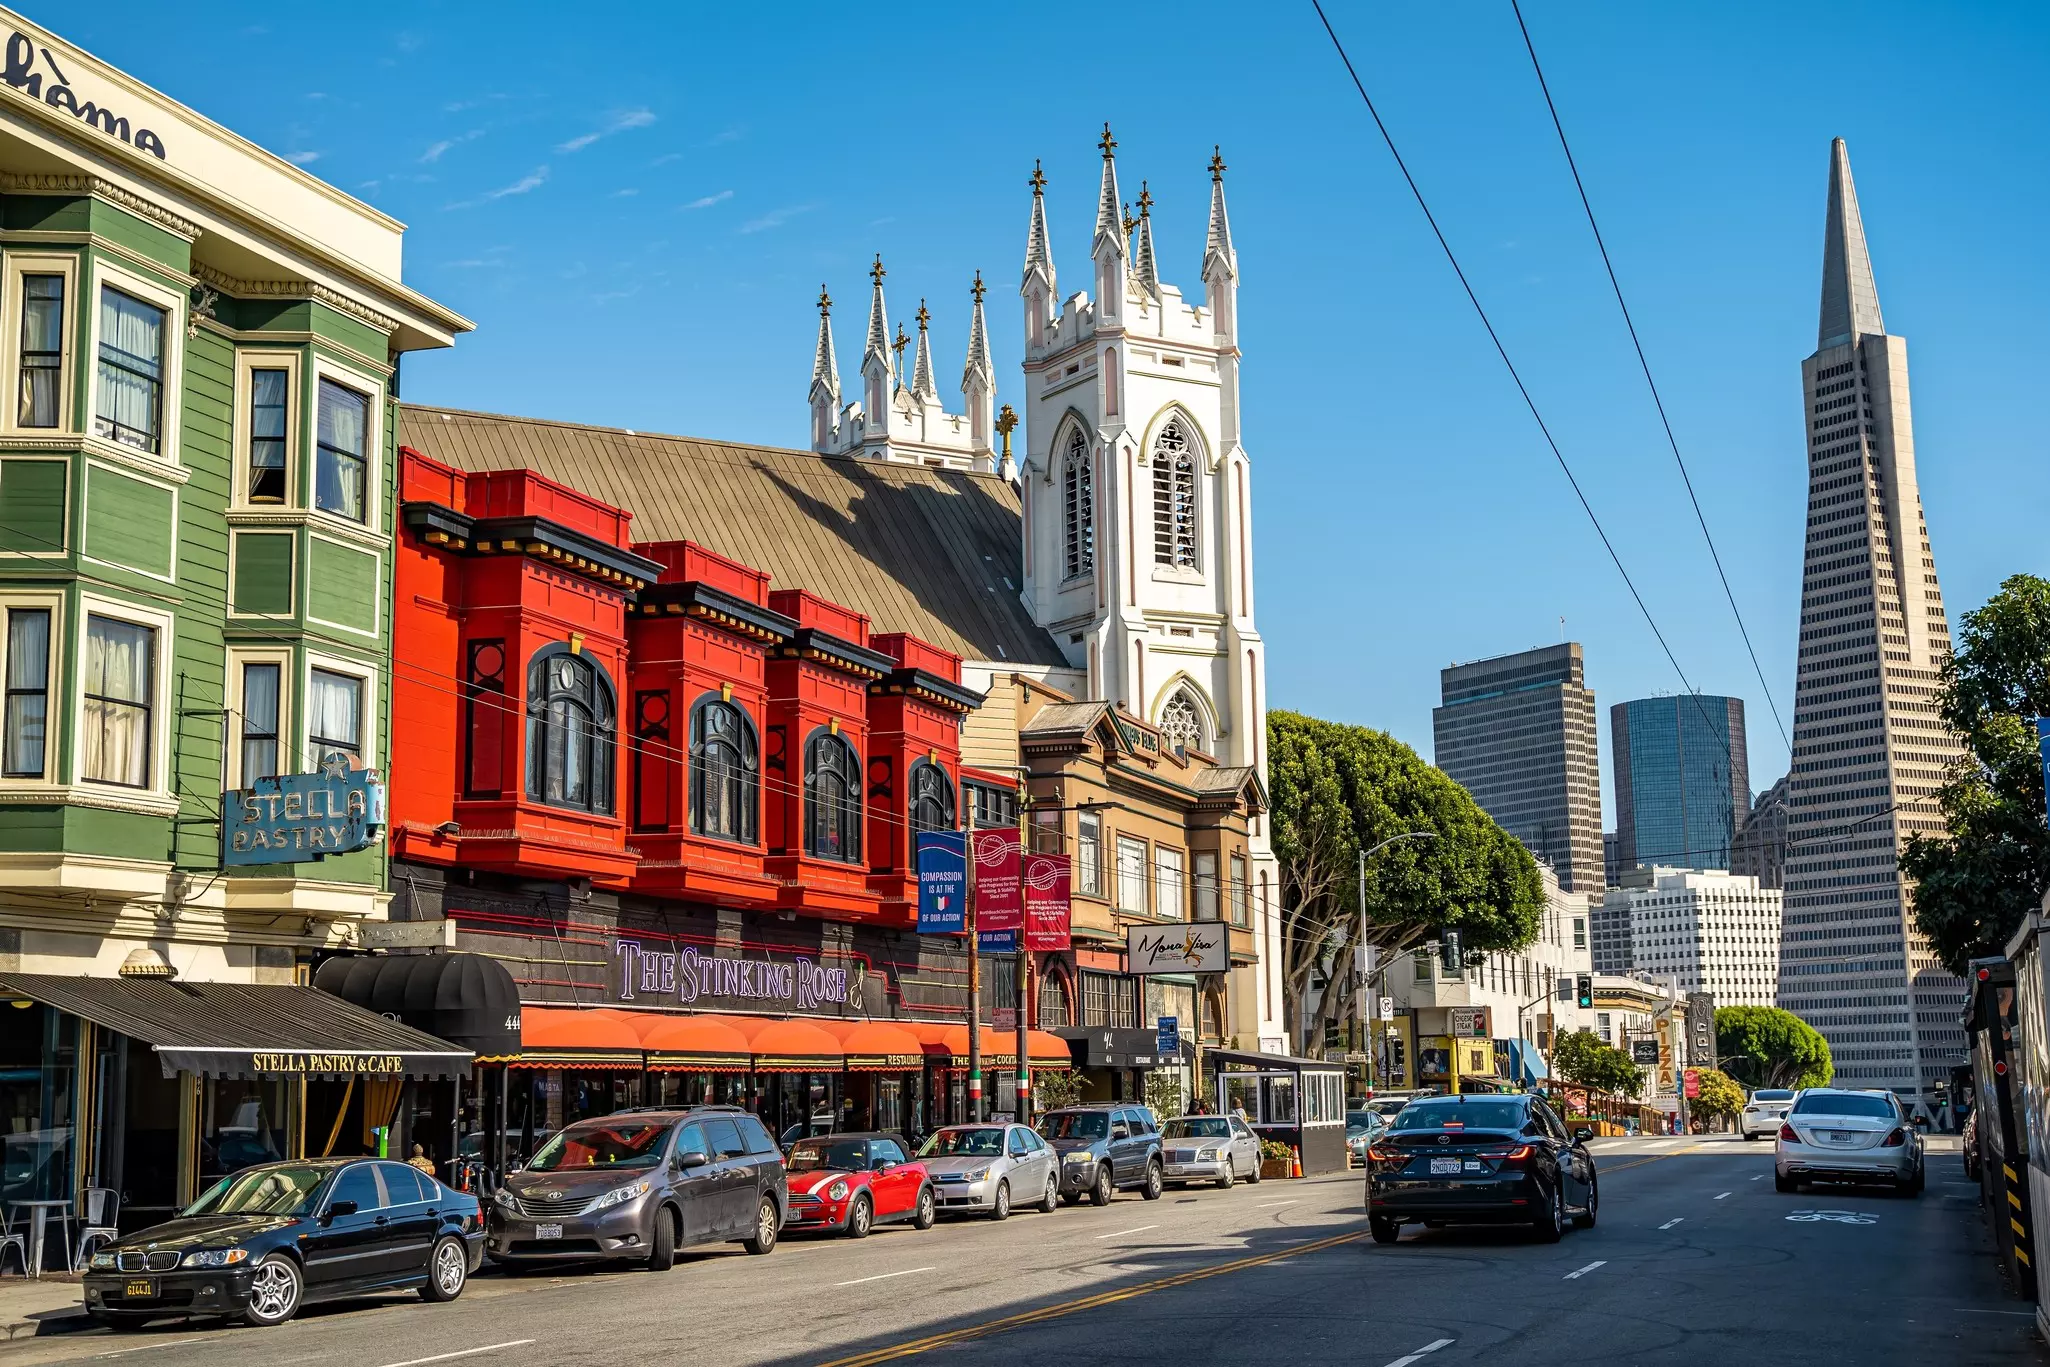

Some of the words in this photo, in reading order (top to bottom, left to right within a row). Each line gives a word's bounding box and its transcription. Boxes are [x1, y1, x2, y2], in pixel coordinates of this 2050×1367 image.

[243, 789, 367, 824] STELLA
[232, 825, 347, 852] PASTRY
[921, 871, 963, 882] COMPASSION
[928, 885, 935, 894] IS
[936, 885, 943, 894] AT
[944, 884, 955, 894] THE
[922, 914, 929, 922] OF
[930, 914, 941, 922] OUR
[942, 913, 960, 922] ACTION
[994, 933, 1011, 941] ACTION
[1138, 934, 1184, 965] Mona
[1183, 932, 1219, 959] Lisa
[616, 939, 677, 1001] THE
[681, 946, 793, 1004] STINKING
[796, 956, 848, 1010] ROSE
[1656, 1018, 1673, 1083] PIZZA
[253, 1053, 306, 1072] STELLA
[309, 1054, 357, 1072] PASTRY
[358, 1058, 367, 1072] &
[368, 1055, 403, 1073] CAFE
[887, 1055, 921, 1065] RESTAURANT
[951, 1056, 969, 1066] THE
